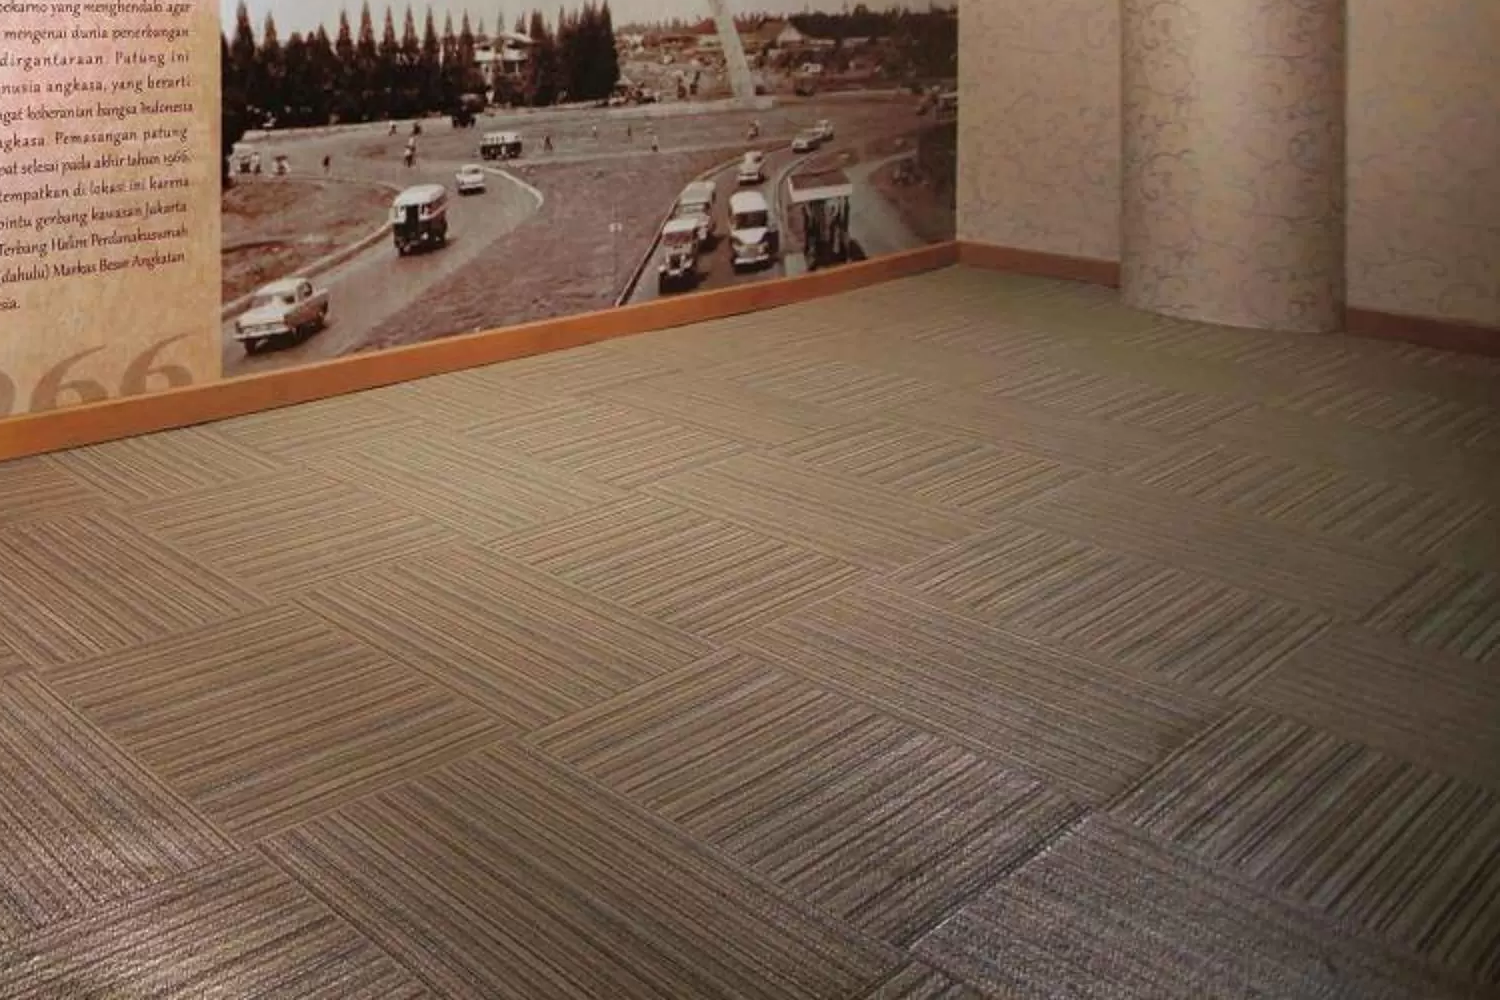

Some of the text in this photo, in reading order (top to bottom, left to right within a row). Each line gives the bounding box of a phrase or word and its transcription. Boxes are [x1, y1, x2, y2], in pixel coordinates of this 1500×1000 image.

[51, 3, 81, 17] yang
[115, 51, 165, 68] Patung
[111, 79, 143, 95] yang
[148, 75, 191, 89] berarti
[55, 128, 137, 146] Pemasangan
[35, 208, 87, 230] gerbang
[144, 201, 187, 220] Jakarta
